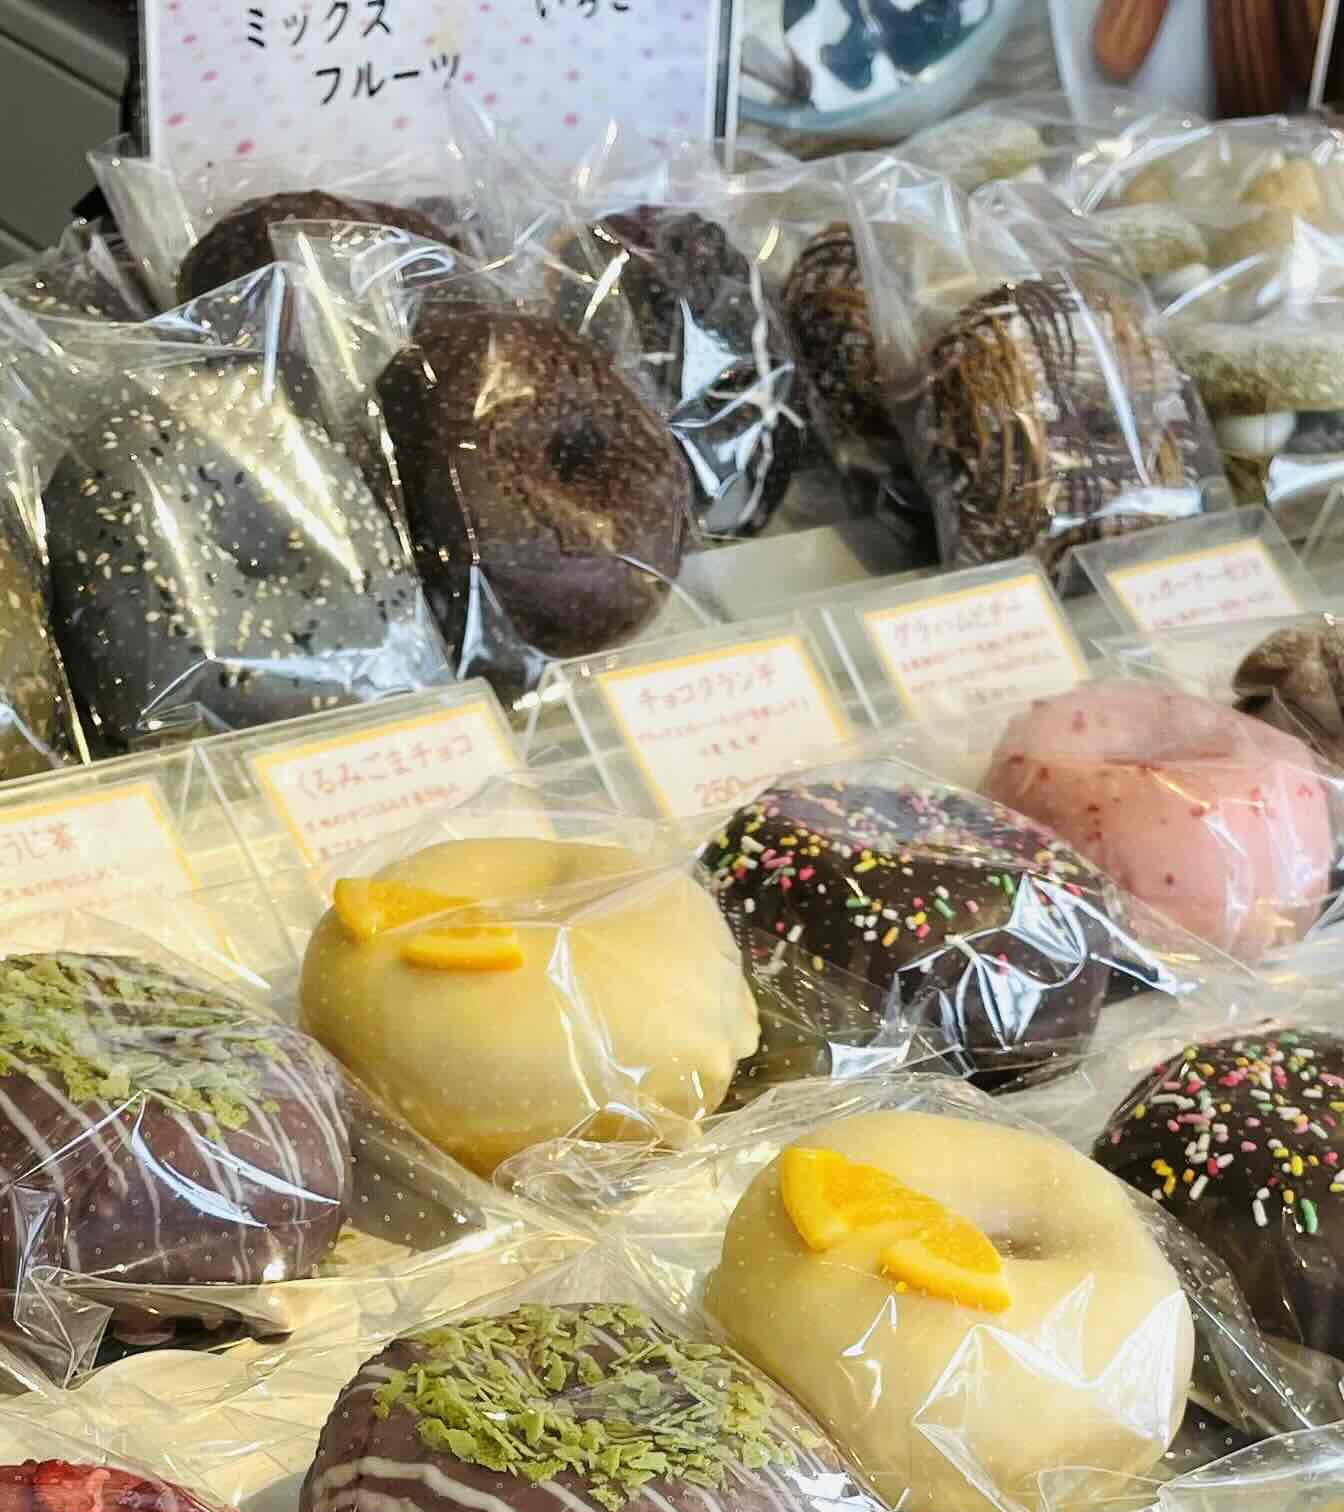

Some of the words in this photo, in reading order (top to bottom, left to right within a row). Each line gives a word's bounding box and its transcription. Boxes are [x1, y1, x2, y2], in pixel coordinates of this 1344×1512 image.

[246, 0, 392, 48] ミックス
[314, 53, 460, 104] フルーツ
